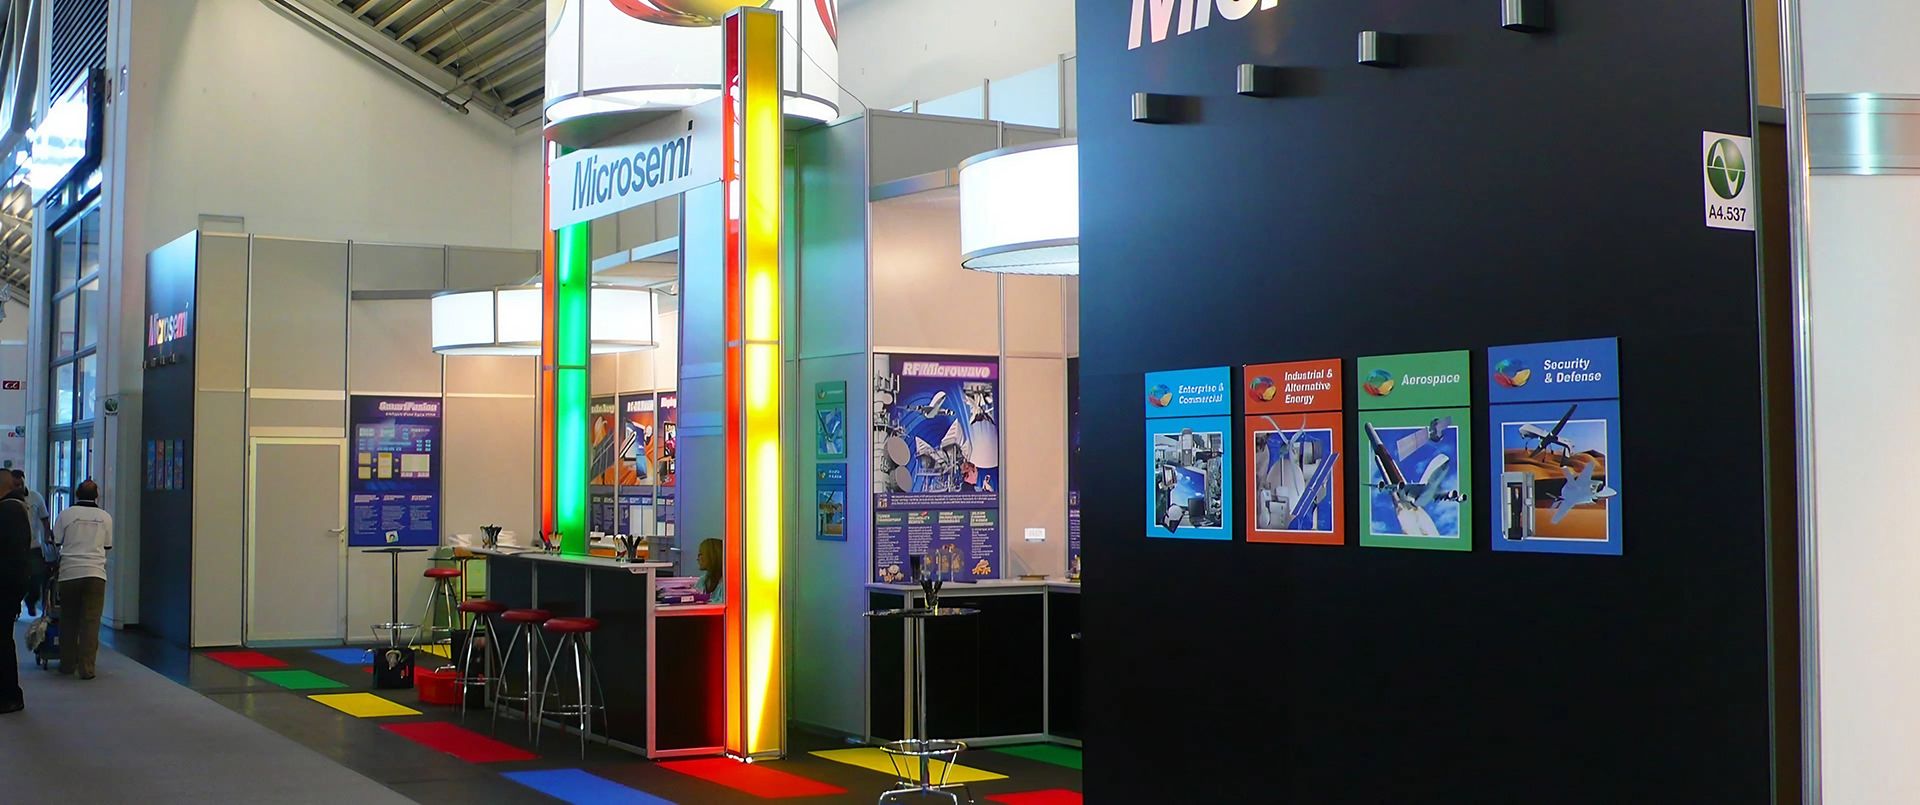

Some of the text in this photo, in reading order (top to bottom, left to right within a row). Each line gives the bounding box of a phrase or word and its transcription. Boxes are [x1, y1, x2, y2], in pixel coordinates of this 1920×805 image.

[572, 119, 693, 211] Microsemi
[1708, 204, 1747, 222] A4.537
[147, 302, 189, 347] Microsemi
[1543, 357, 1591, 371] Security
[1284, 368, 1333, 382] Industrial &
[1401, 373, 1461, 387] Aerospace
[1544, 370, 1602, 384] & Defense
[1177, 382, 1225, 395] Enterprise &
[1284, 381, 1331, 393] Alternative
[1178, 394, 1224, 405] Commercial
[1284, 393, 1315, 405] Energy
